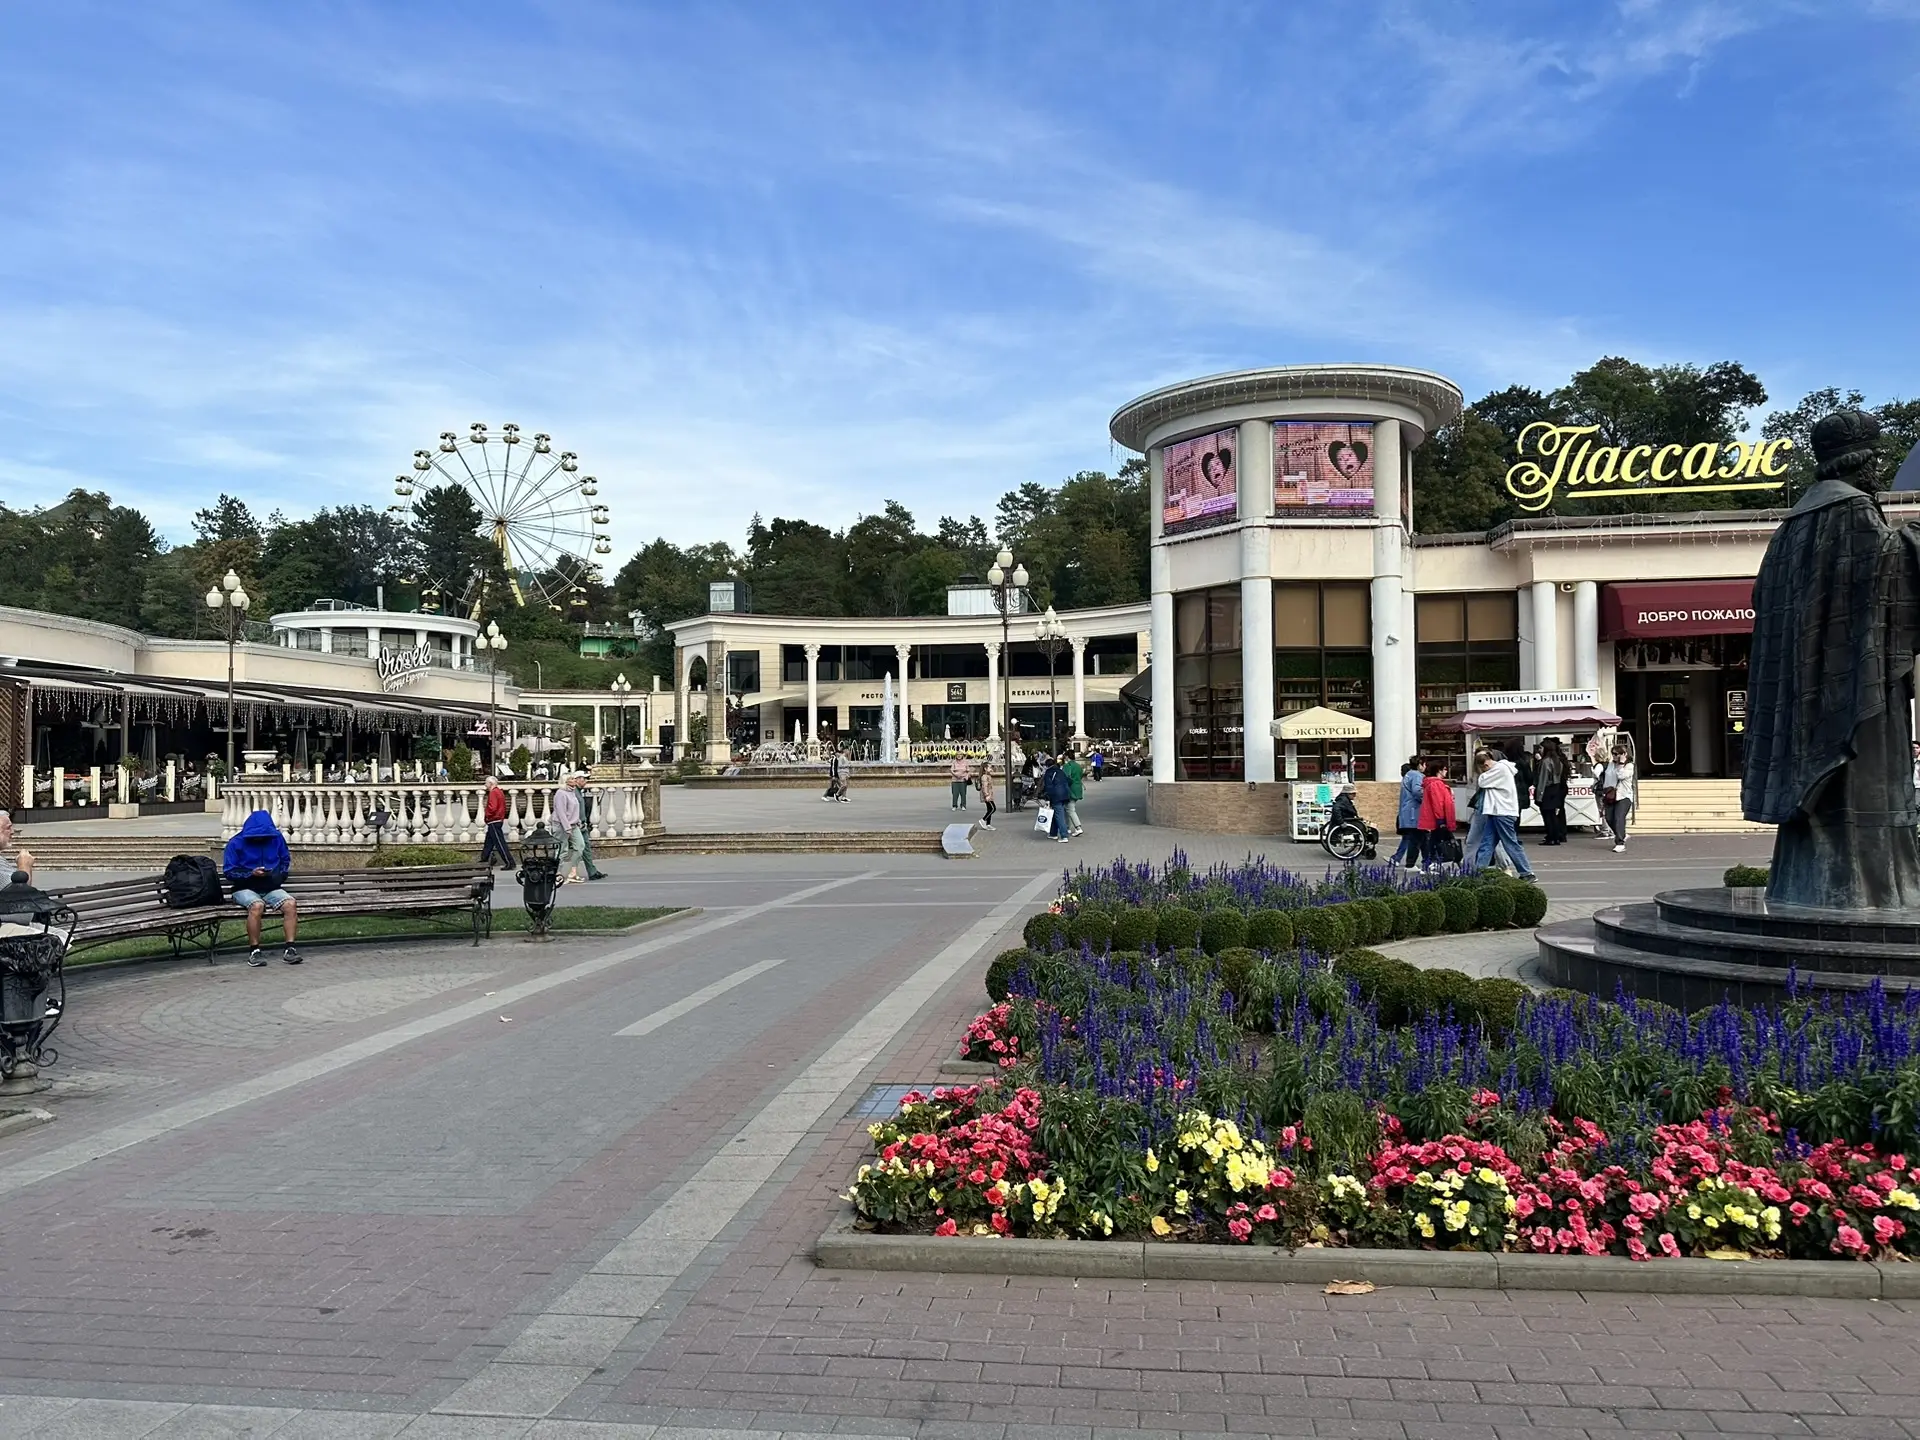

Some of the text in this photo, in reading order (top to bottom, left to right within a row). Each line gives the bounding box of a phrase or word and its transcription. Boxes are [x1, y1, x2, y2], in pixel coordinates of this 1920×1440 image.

[1506, 421, 1793, 511] Пассаж
[1637, 610, 1688, 624] ДОБРО
[1485, 693, 1584, 704] ЧИПСЫ БЛИНЫ
[1292, 727, 1360, 736] ЭКСКУРСИИ
